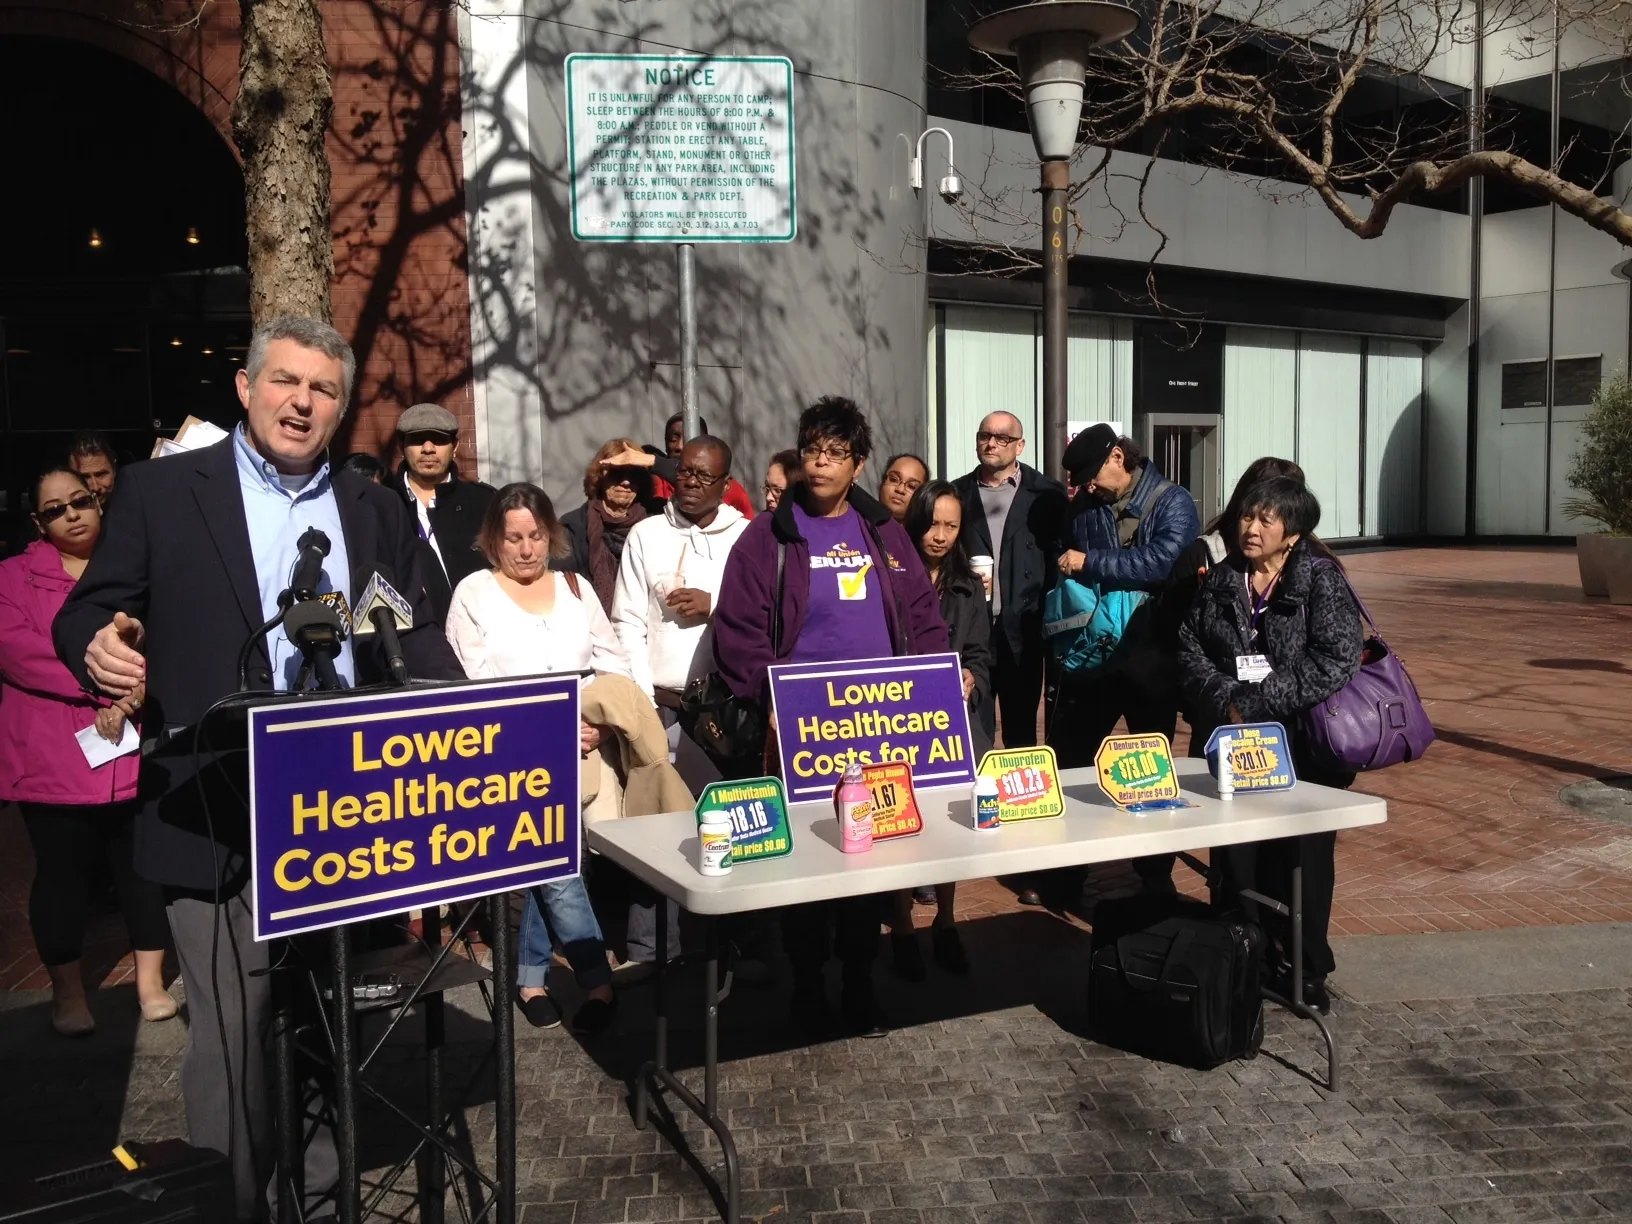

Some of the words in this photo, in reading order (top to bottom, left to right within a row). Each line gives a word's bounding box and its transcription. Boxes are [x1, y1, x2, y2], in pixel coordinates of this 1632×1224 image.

[645, 68, 715, 86] NOTICE
[588, 93, 596, 102] IT
[599, 93, 607, 102] IS
[610, 93, 655, 102] UNLAWFUL
[658, 94, 674, 102] FOR
[678, 94, 694, 103] ANY
[698, 94, 730, 104] PERSON
[733, 95, 744, 104] TO
[587, 106, 614, 116] SLEEP
[616, 107, 656, 116] BETWEEN
[660, 108, 674, 116] THE
[678, 108, 706, 116] HOURS
[710, 108, 720, 116] OF
[724, 108, 743, 116] 8:00
[746, 108, 762, 117] P.M.
[768, 108, 774, 117] &
[597, 121, 616, 130] 8:00
[644, 122, 678, 130] PEDDLE
[681, 122, 692, 130] OR
[696, 122, 717, 130] VEND
[720, 122, 756, 131] WITHOUT
[760, 123, 766, 131] A
[635, 135, 670, 144] STATION
[674, 136, 686, 144] OR
[688, 136, 715, 144] ERECT
[718, 136, 734, 144] ANY
[738, 136, 768, 146] TABLE,
[593, 150, 642, 160] PLATFORM,
[646, 150, 676, 160] STAND,
[680, 150, 726, 160] MONUMENT
[730, 151, 740, 160] OR
[744, 151, 771, 160] OTHER
[590, 163, 640, 172] STRUCTURE
[644, 164, 652, 172] IN
[656, 164, 672, 172] ANY
[676, 164, 698, 172] PARK
[701, 164, 726, 174] AREA,
[730, 164, 775, 174] INCLUDING
[592, 177, 608, 186] THE
[611, 178, 648, 187] PLAZAS,
[651, 178, 688, 186] WITHOUT
[690, 178, 742, 186] PERMISSION
[746, 178, 756, 186] OF
[758, 178, 774, 186] THE
[624, 192, 676, 200] RECREATION
[682, 192, 689, 200] &
[694, 192, 716, 200] PARK
[720, 192, 744, 200] DEPT.
[826, 680, 914, 707] Lower
[798, 709, 950, 743] Healthcare
[1238, 729, 1242, 738] 1
[1244, 728, 1260, 738] Dose
[1114, 741, 1140, 750] Denture
[1140, 739, 1160, 748] Brush
[1232, 738, 1254, 746] ocaine
[1256, 736, 1278, 745] Cream
[352, 723, 501, 772] Lower
[792, 747, 871, 778] Costs
[880, 742, 920, 766] for
[928, 735, 964, 764] All
[991, 756, 996, 768] 1
[999, 754, 1046, 768] Ibuprofen
[1235, 750, 1268, 770] $20.11
[1118, 752, 1158, 780] $73.00
[1233, 778, 1250, 788] etail
[1252, 778, 1269, 788] price
[710, 790, 716, 804] 1
[718, 784, 777, 803] Multivitamin
[1118, 790, 1136, 800] Retail
[1138, 791, 1153, 800] price
[292, 767, 550, 835] Healthcare
[979, 798, 998, 808] Adv
[1000, 808, 1018, 818] Retail
[1020, 806, 1038, 816] price
[879, 822, 896, 834] price
[274, 837, 415, 892] Costs
[428, 824, 495, 866] for
[507, 804, 564, 852] All
[731, 844, 742, 856] tail
[744, 843, 763, 856] price
